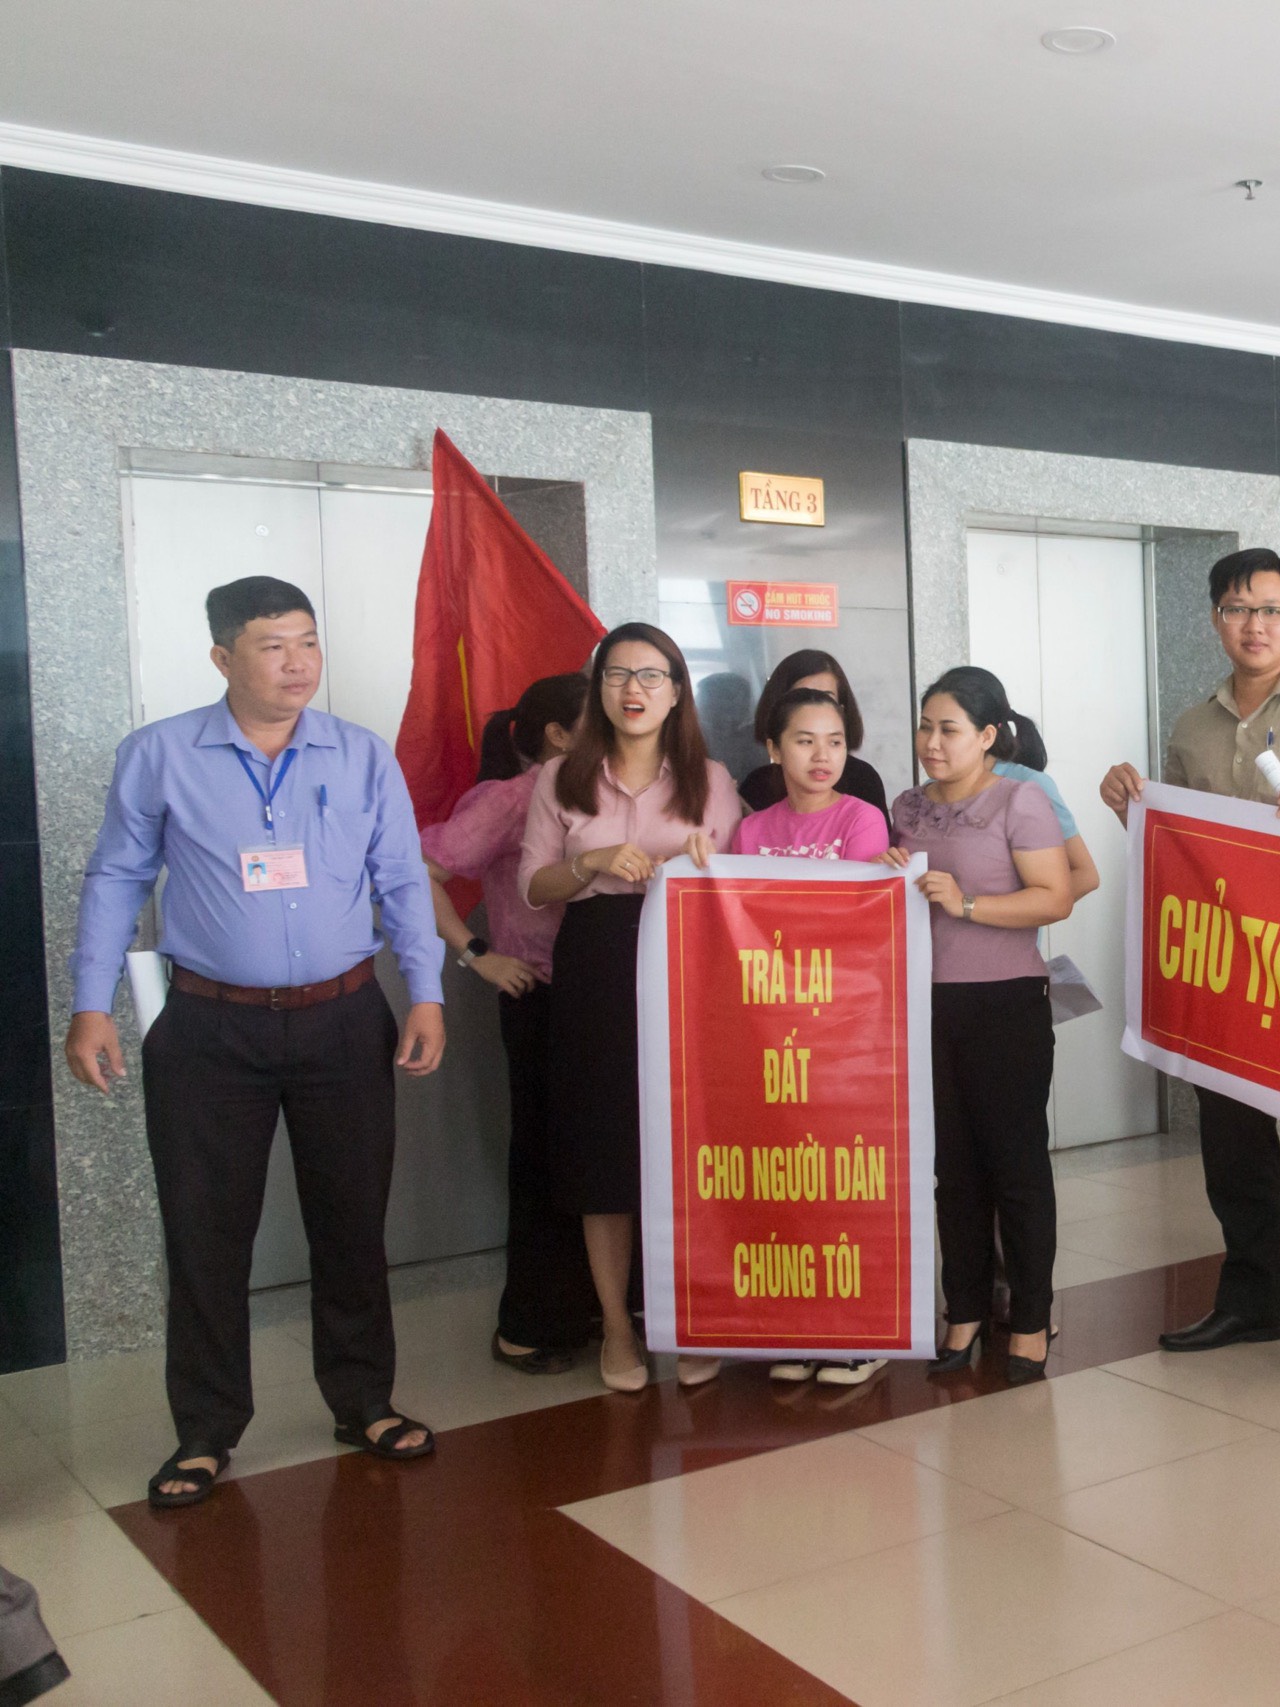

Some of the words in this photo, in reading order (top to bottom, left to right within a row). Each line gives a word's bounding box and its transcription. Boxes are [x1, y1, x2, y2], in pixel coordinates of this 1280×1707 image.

[751, 479, 801, 512] TẦNG
[807, 493, 817, 514] 3
[765, 608, 781, 620] NO
[783, 609, 832, 622] SMOKING
[1159, 878, 1234, 994] CHỦ
[738, 930, 787, 1005] TRẢ
[794, 948, 832, 1017] LẠI
[763, 1028, 811, 1104] ĐẤT
[697, 1145, 746, 1201] CHO
[752, 1133, 827, 1202] NGƯỜI
[834, 1134, 886, 1201] DÂN
[733, 1233, 816, 1299] CHÚNG
[822, 1232, 861, 1299] TÔI
